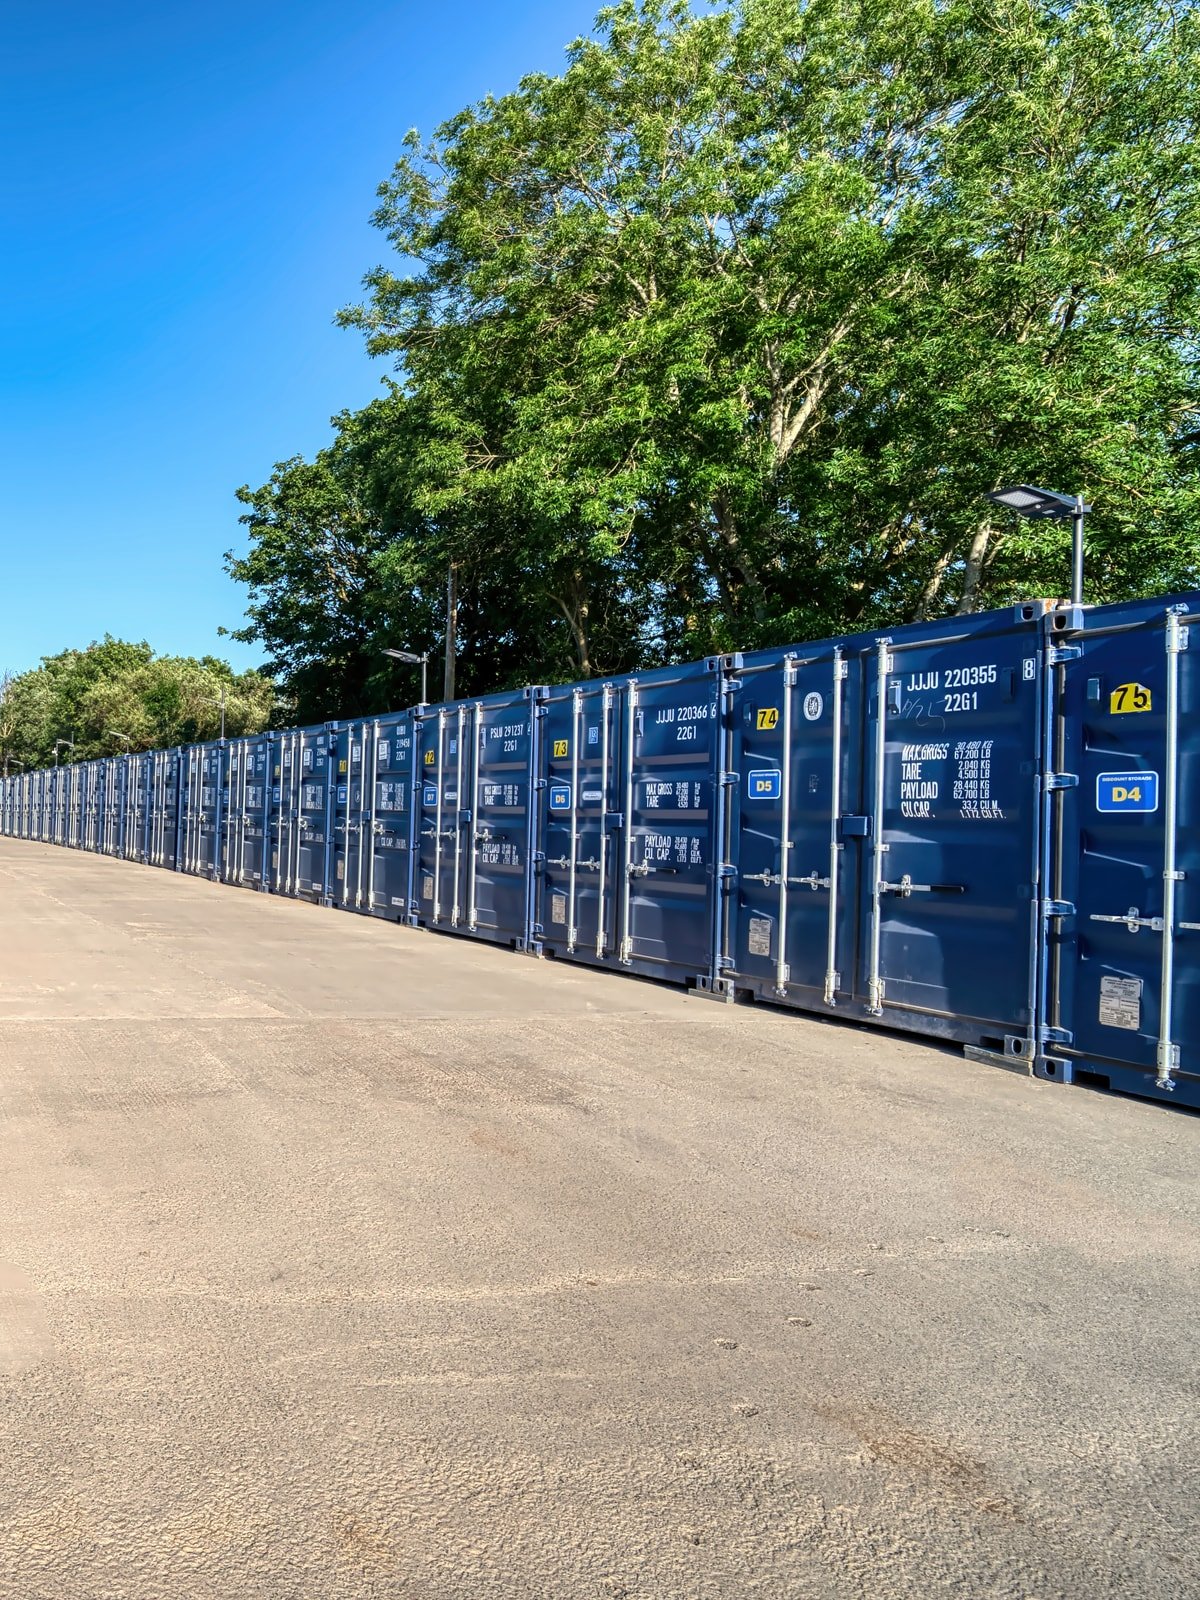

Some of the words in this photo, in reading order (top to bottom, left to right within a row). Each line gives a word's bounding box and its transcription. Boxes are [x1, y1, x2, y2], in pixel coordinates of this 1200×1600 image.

[1024, 659, 1034, 680] 8
[907, 671, 939, 692] JJJU
[944, 664, 997, 688] 220355
[944, 691, 978, 712] 22G1
[1115, 686, 1148, 711] 75
[656, 708, 675, 724] JJJU
[677, 704, 708, 721] 220366
[759, 710, 776, 728] 74
[504, 724, 523, 737] 291237
[677, 725, 697, 740] 22G1
[555, 743, 567, 755] 73
[980, 748, 991, 759] LB
[901, 762, 922, 780] TARE
[980, 760, 991, 769] KG
[980, 768, 990, 779] LB
[657, 783, 672, 795] GROSS
[756, 780, 772, 792] D5
[901, 781, 939, 799] PAYLOAD
[980, 780, 990, 790] KG
[646, 795, 659, 808] TARE
[980, 789, 990, 799] LB
[1112, 786, 1141, 802] D4
[644, 835, 672, 848] PAYLOAD
